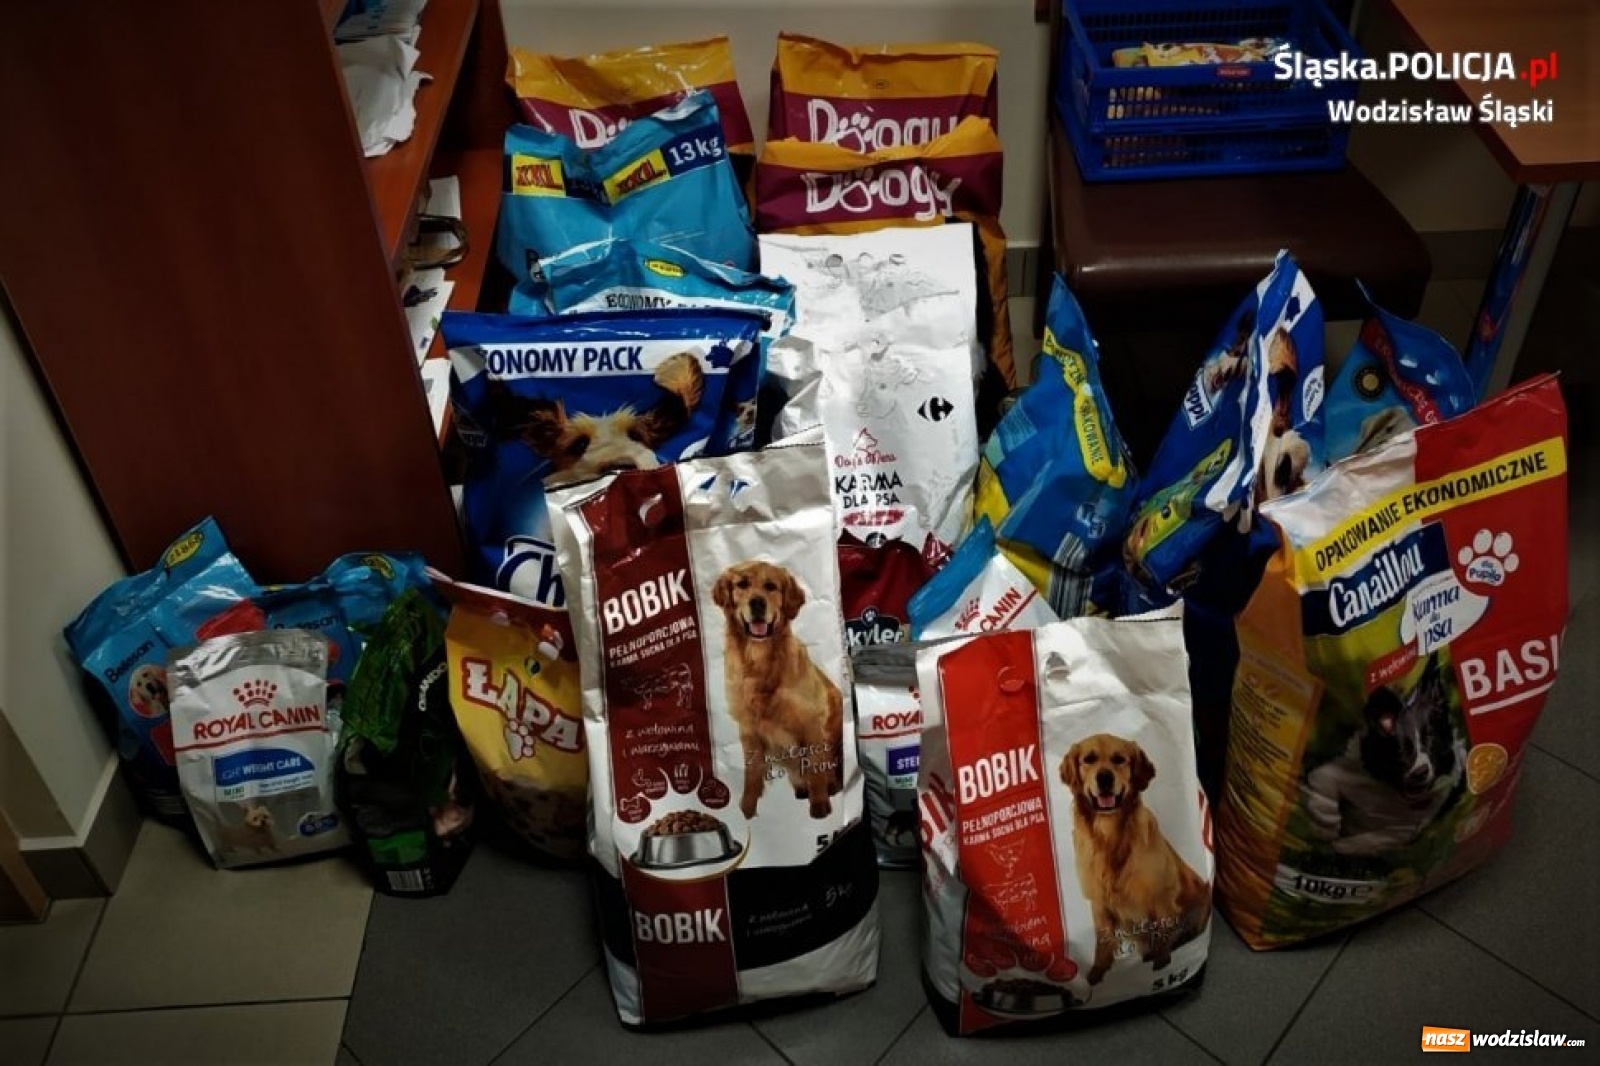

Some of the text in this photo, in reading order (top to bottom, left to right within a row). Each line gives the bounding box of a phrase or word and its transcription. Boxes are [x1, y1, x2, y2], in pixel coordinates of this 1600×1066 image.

[583, 346, 643, 371] PACK
[834, 470, 903, 494] KARMA
[843, 495, 868, 508] DLA
[1315, 451, 1548, 571] OPAKOWANIE EKONOMICZNE
[602, 568, 692, 636] BOBIK
[1329, 542, 1426, 628] Canaillou
[609, 615, 696, 660] PEŁNOPORCJOWA
[194, 705, 321, 740] ROYAL CANIN
[958, 744, 1039, 806] BOBIK
[634, 907, 727, 945] BOBIK
